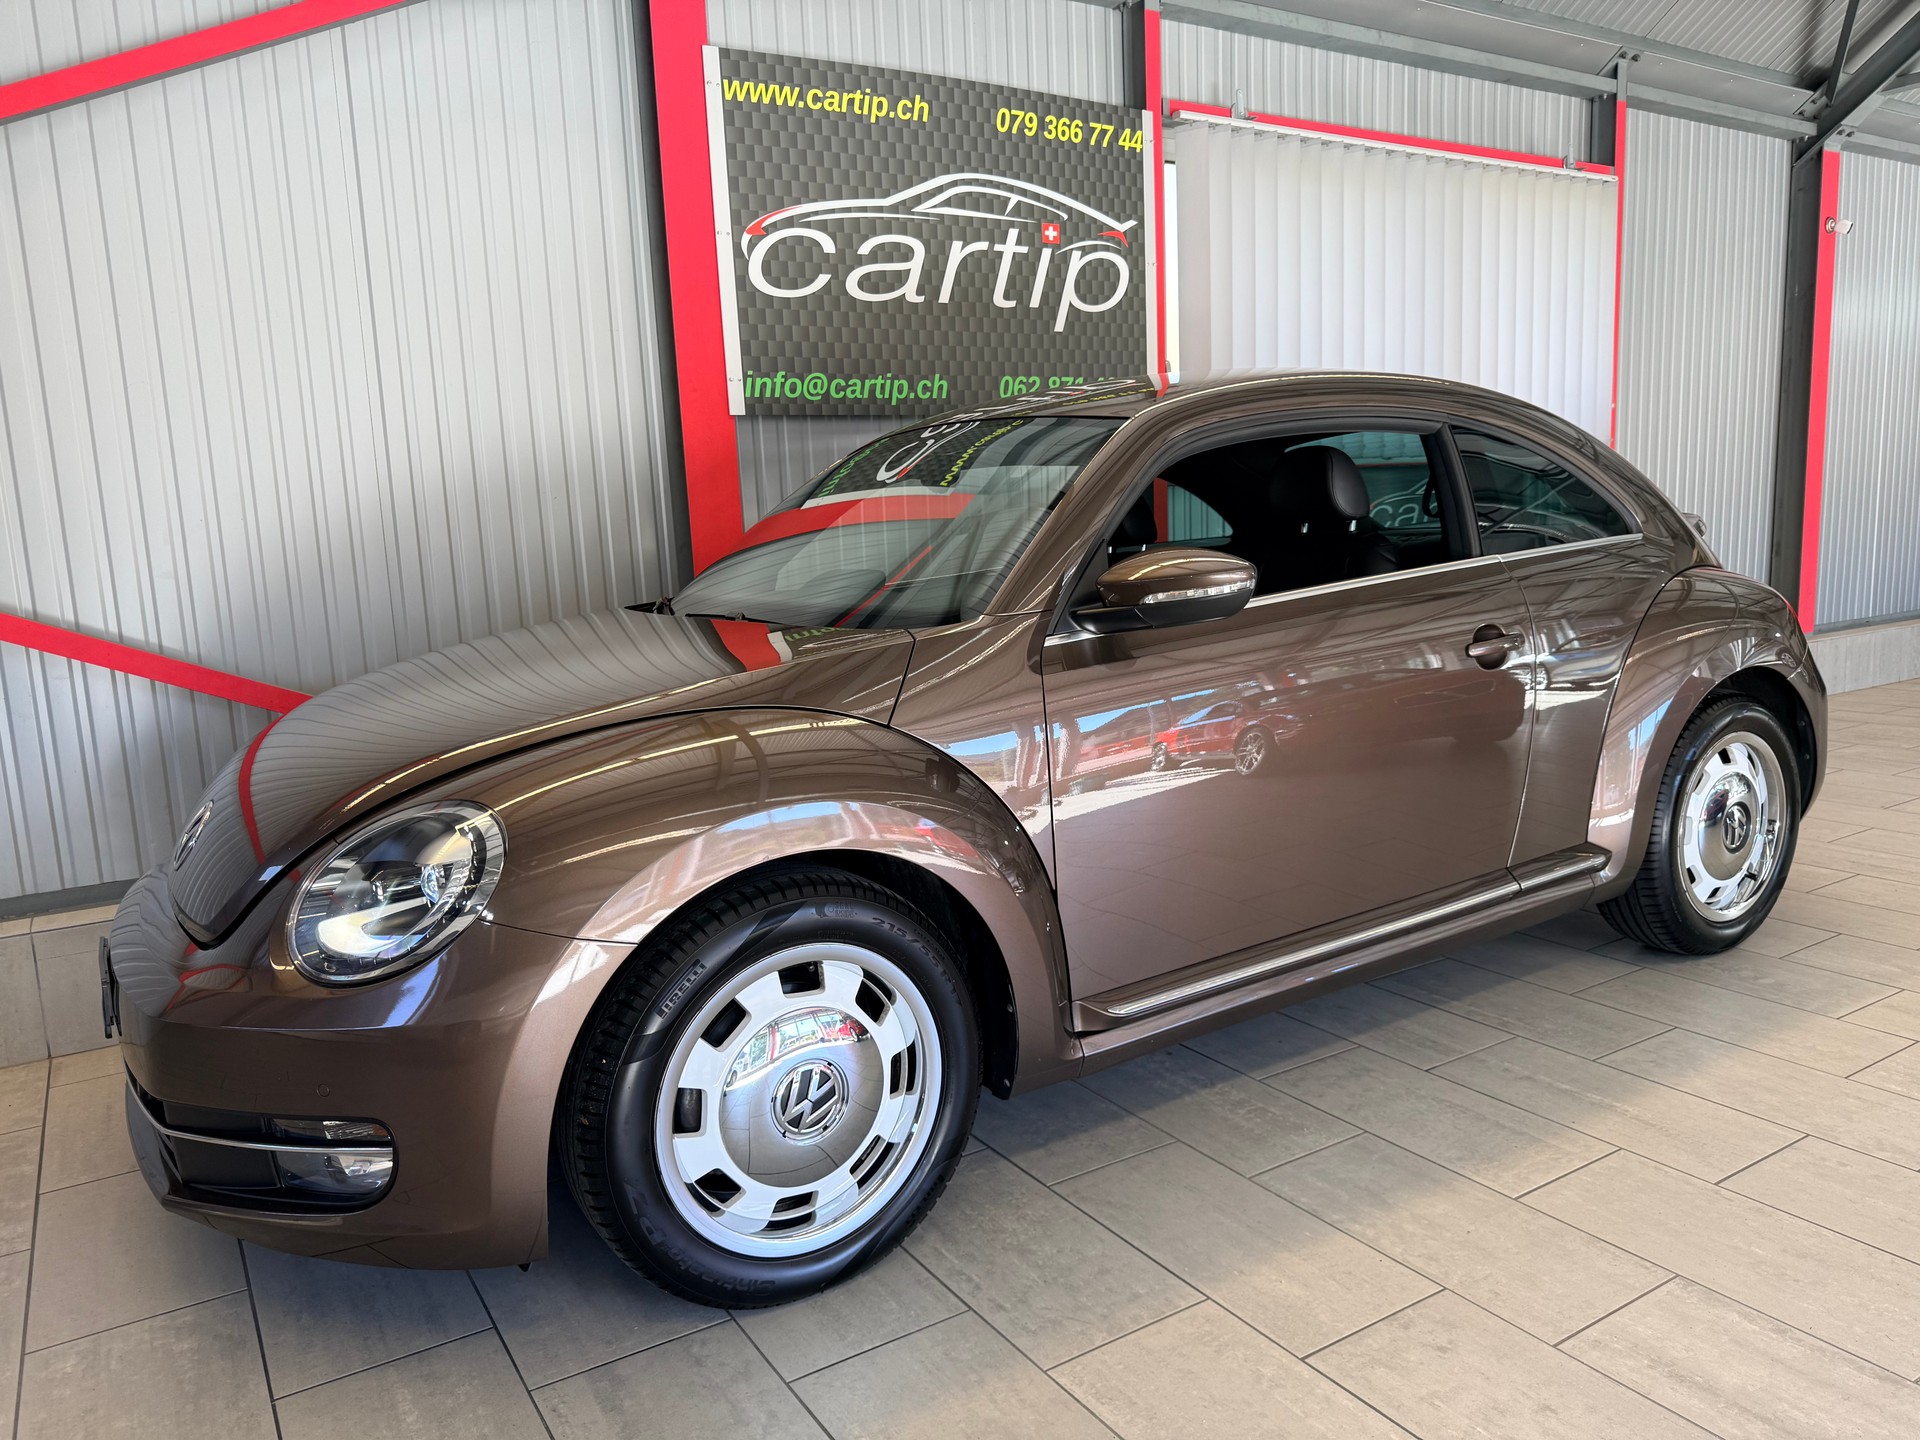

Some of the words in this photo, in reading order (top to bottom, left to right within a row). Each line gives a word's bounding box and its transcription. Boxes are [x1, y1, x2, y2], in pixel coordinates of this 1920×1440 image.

[723, 79, 930, 123] www.cartip.ch
[996, 107, 1039, 138] 079
[1044, 115, 1084, 144] 366
[1089, 121, 1115, 148] 77
[1118, 129, 1144, 153] 44
[747, 225, 1131, 333] cartip
[744, 369, 949, 405] info@cartip.ch
[999, 374, 1042, 400] 062
[655, 959, 708, 1019] PIRELLI
